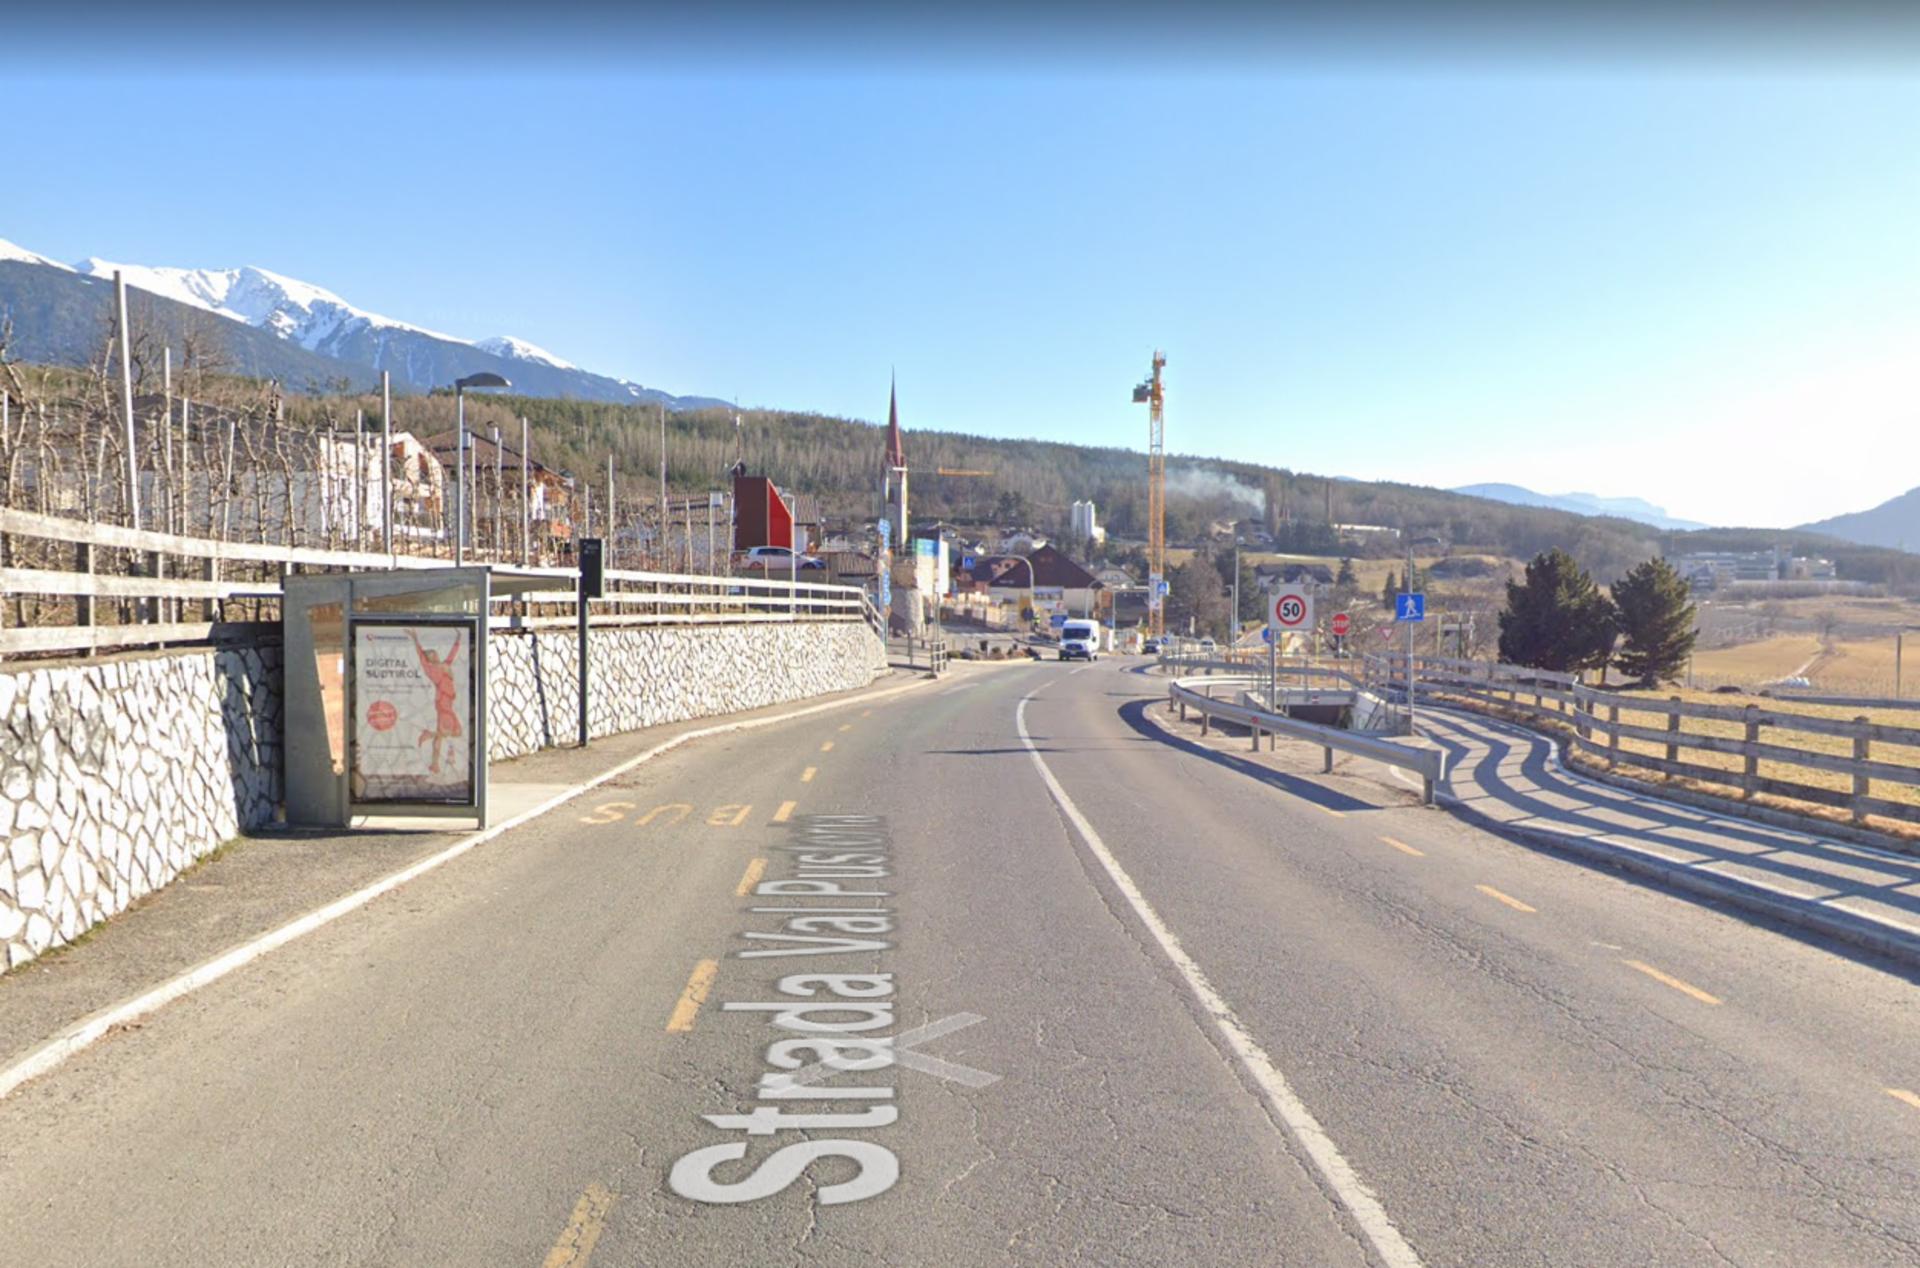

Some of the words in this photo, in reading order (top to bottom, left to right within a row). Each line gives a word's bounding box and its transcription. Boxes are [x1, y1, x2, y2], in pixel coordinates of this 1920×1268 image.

[1283, 602, 1300, 617] 50
[1332, 619, 1350, 628] STOP
[366, 659, 408, 668] DIGITAL
[580, 801, 752, 827] BUS
